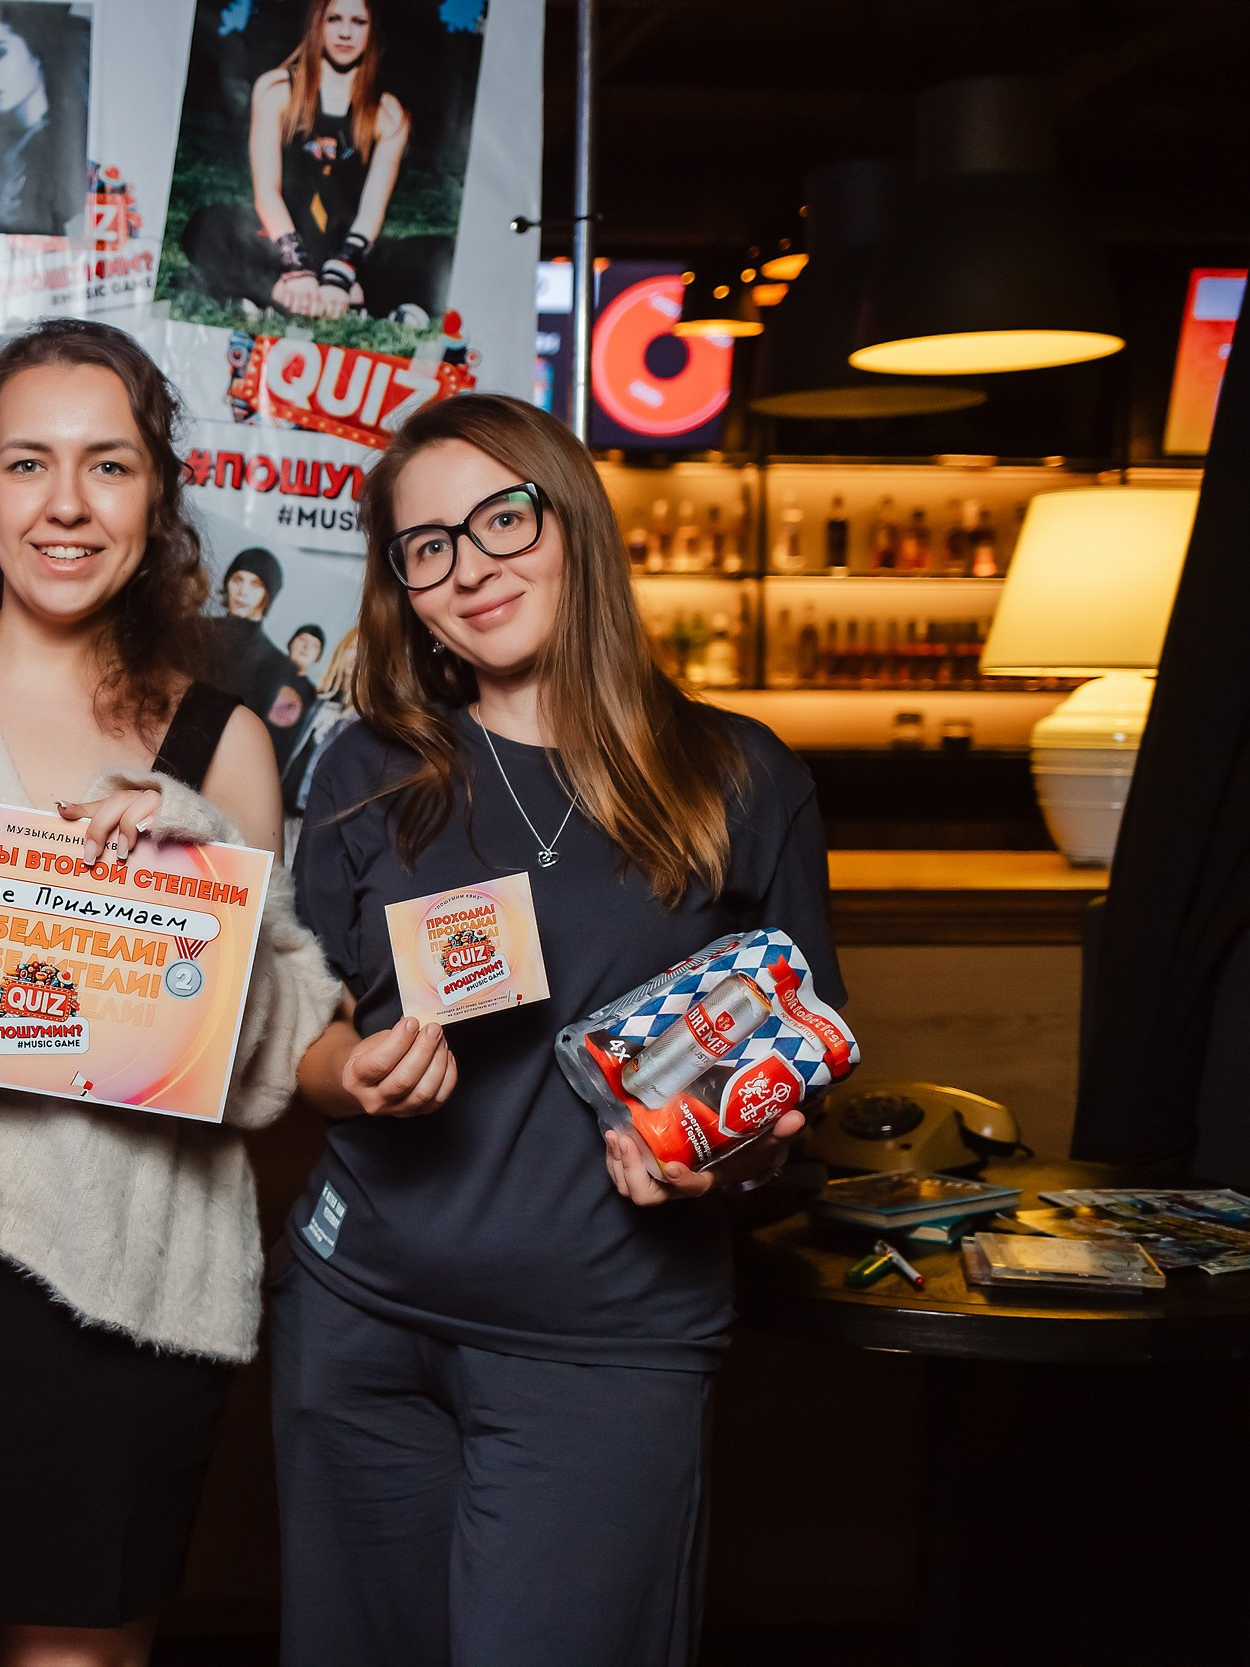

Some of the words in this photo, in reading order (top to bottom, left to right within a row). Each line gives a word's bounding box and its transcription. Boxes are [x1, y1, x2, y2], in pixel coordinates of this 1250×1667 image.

[265, 336, 441, 431] QUIZ
[278, 504, 362, 532] #MUS
[6, 824, 85, 846] МУЗЫКАЛЬН
[25, 850, 129, 885] ВТОРОЙ
[133, 869, 249, 907] СТЕПЕНИ
[35, 887, 187, 932] Придумаем
[426, 903, 495, 929] ПРОХОДКА!
[448, 945, 487, 968] QUIZ
[175, 968, 193, 991] 2
[488, 969, 505, 981] GAME
[7, 986, 66, 1017] QUIZ
[17, 1040, 52, 1049] #MUSIC
[54, 1039, 80, 1048] GAME
[687, 1007, 731, 1055] BREMEN
